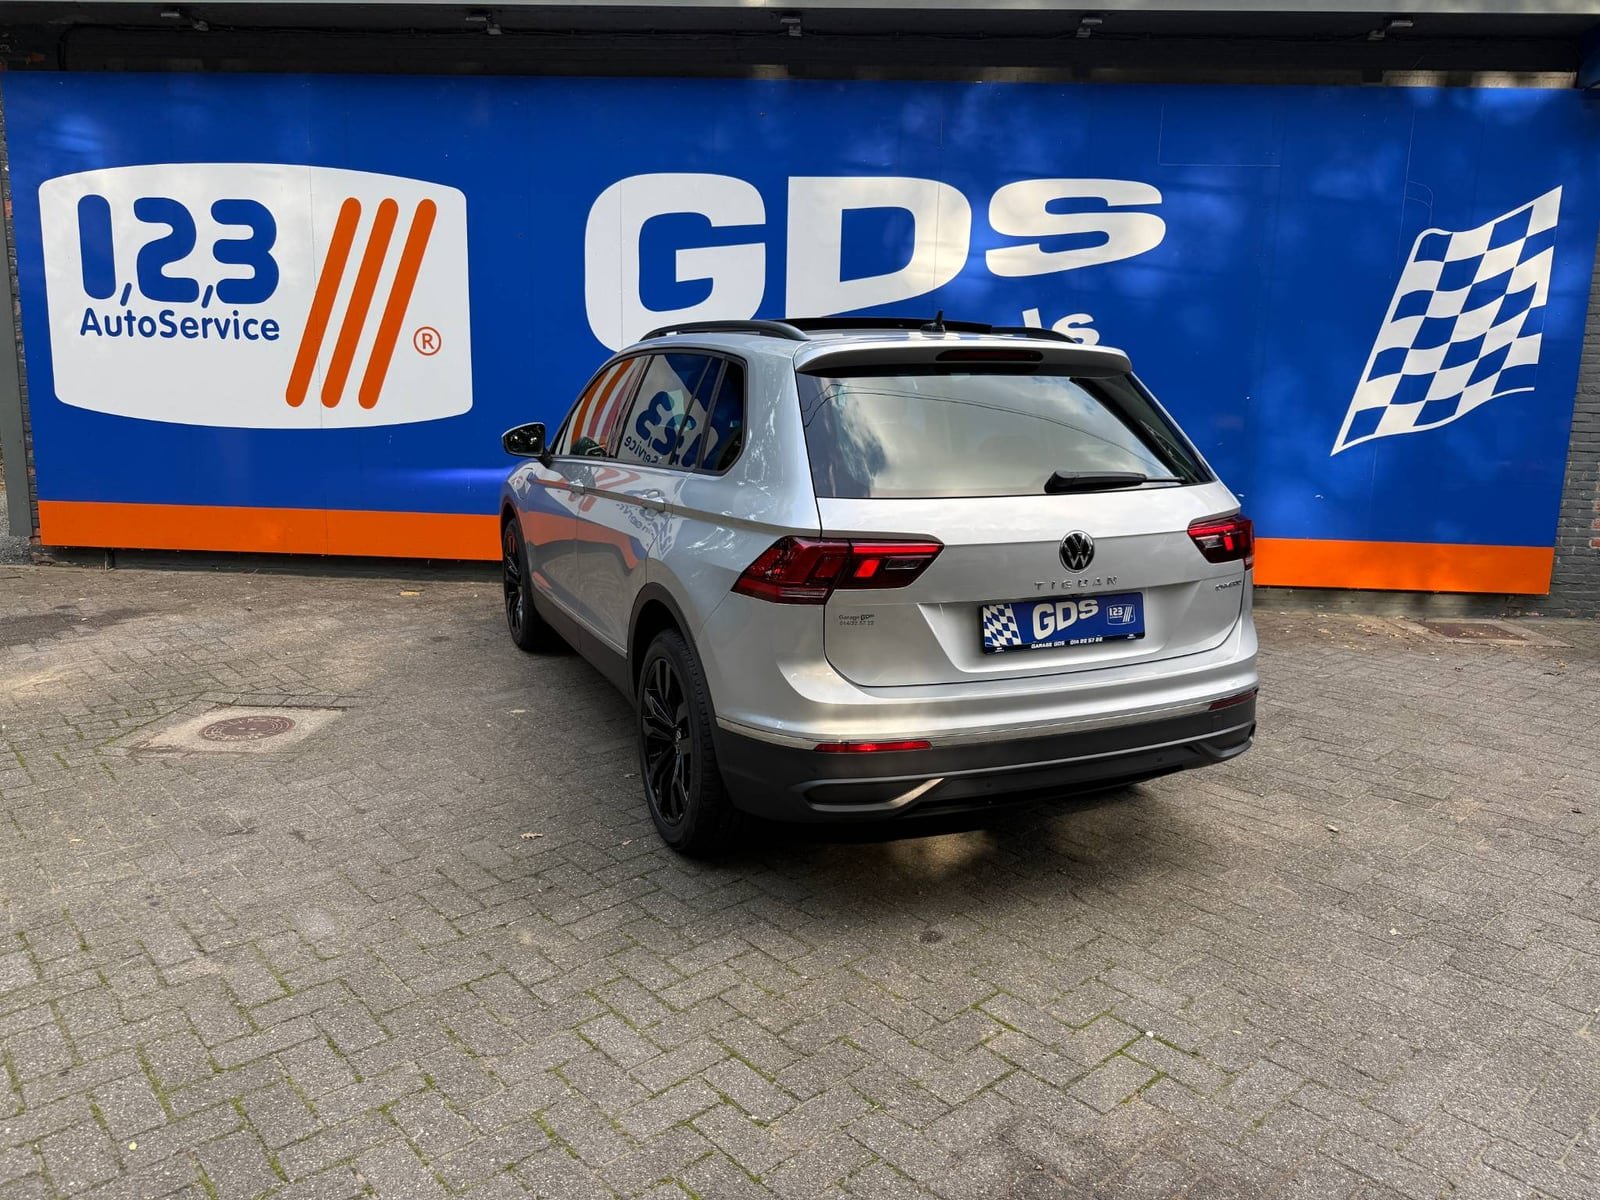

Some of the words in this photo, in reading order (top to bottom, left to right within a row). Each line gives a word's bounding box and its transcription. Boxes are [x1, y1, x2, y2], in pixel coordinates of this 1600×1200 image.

[584, 172, 1167, 353] GDS
[79, 308, 281, 341] AutoService
[1034, 576, 1118, 590] TIGUAN
[1032, 599, 1099, 640] GDS
